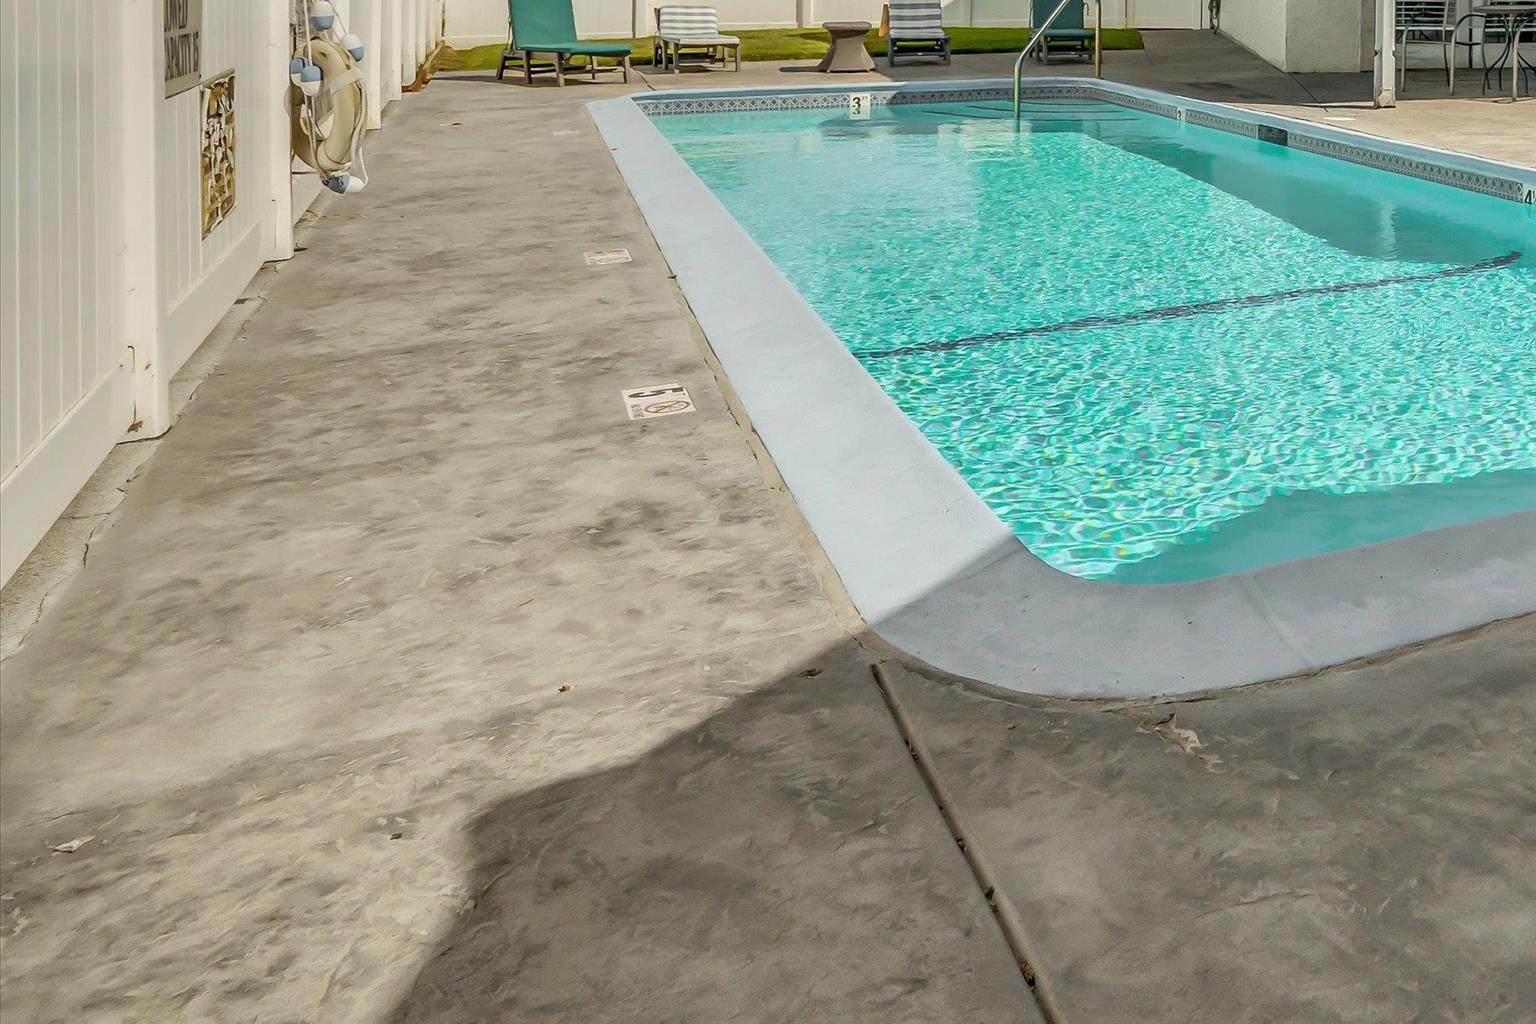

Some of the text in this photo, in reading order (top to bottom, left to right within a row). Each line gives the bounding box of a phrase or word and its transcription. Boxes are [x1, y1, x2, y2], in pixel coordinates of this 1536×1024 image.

[164, 32, 191, 82] APACITY
[852, 96, 861, 109] 3
[628, 386, 684, 398] 5
